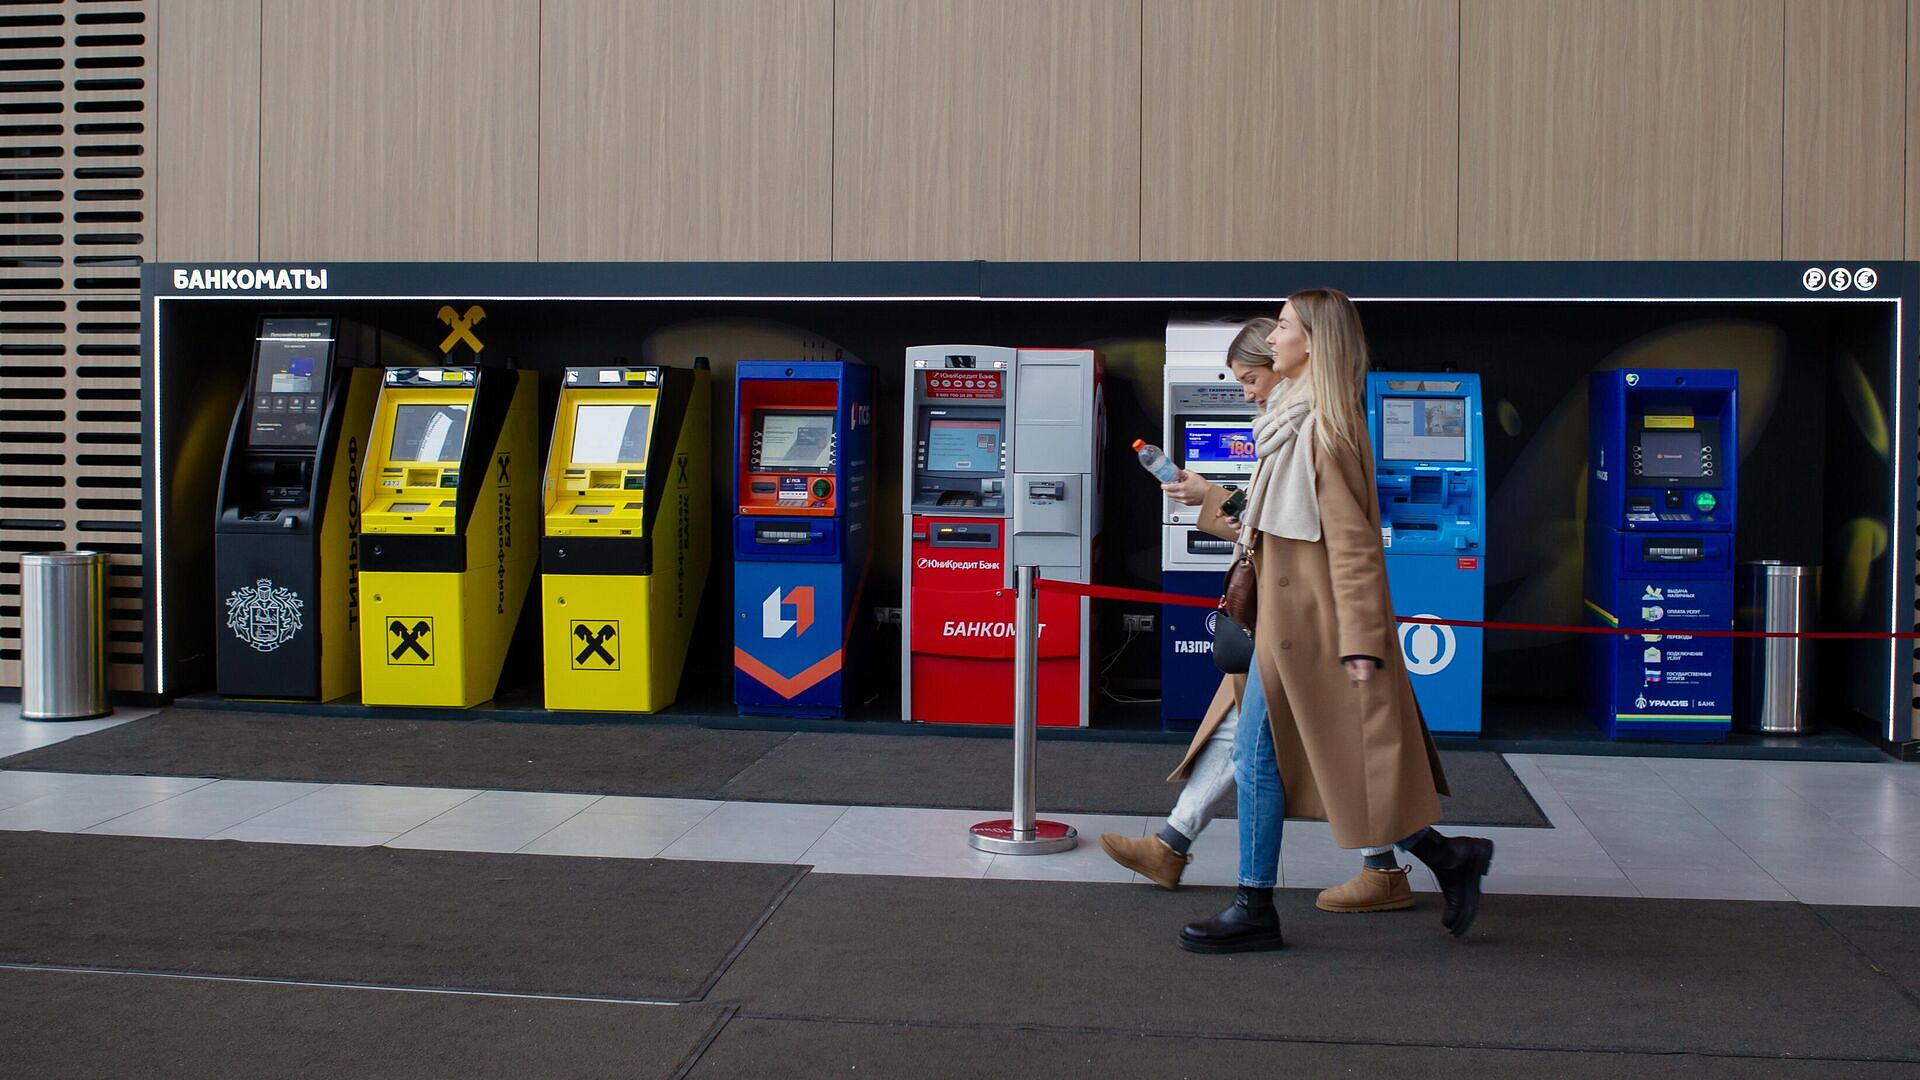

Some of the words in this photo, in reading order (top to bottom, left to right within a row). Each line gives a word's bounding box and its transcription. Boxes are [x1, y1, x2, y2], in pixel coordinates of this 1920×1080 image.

[173, 268, 327, 290] БАНКОМАТЫ
[504, 492, 512, 548] БАНК
[349, 436, 359, 631] ТИНЬКОФФ
[497, 492, 505, 615] Райффайзен
[928, 559, 978, 571] ЮниКредит
[979, 560, 1000, 570] Банк
[943, 621, 1047, 639] БАНКОМТ
[1175, 640, 1214, 654] ГАЗПР
[1649, 699, 1689, 708] УРАЛСИБ
[1697, 700, 1716, 708] БАНК
